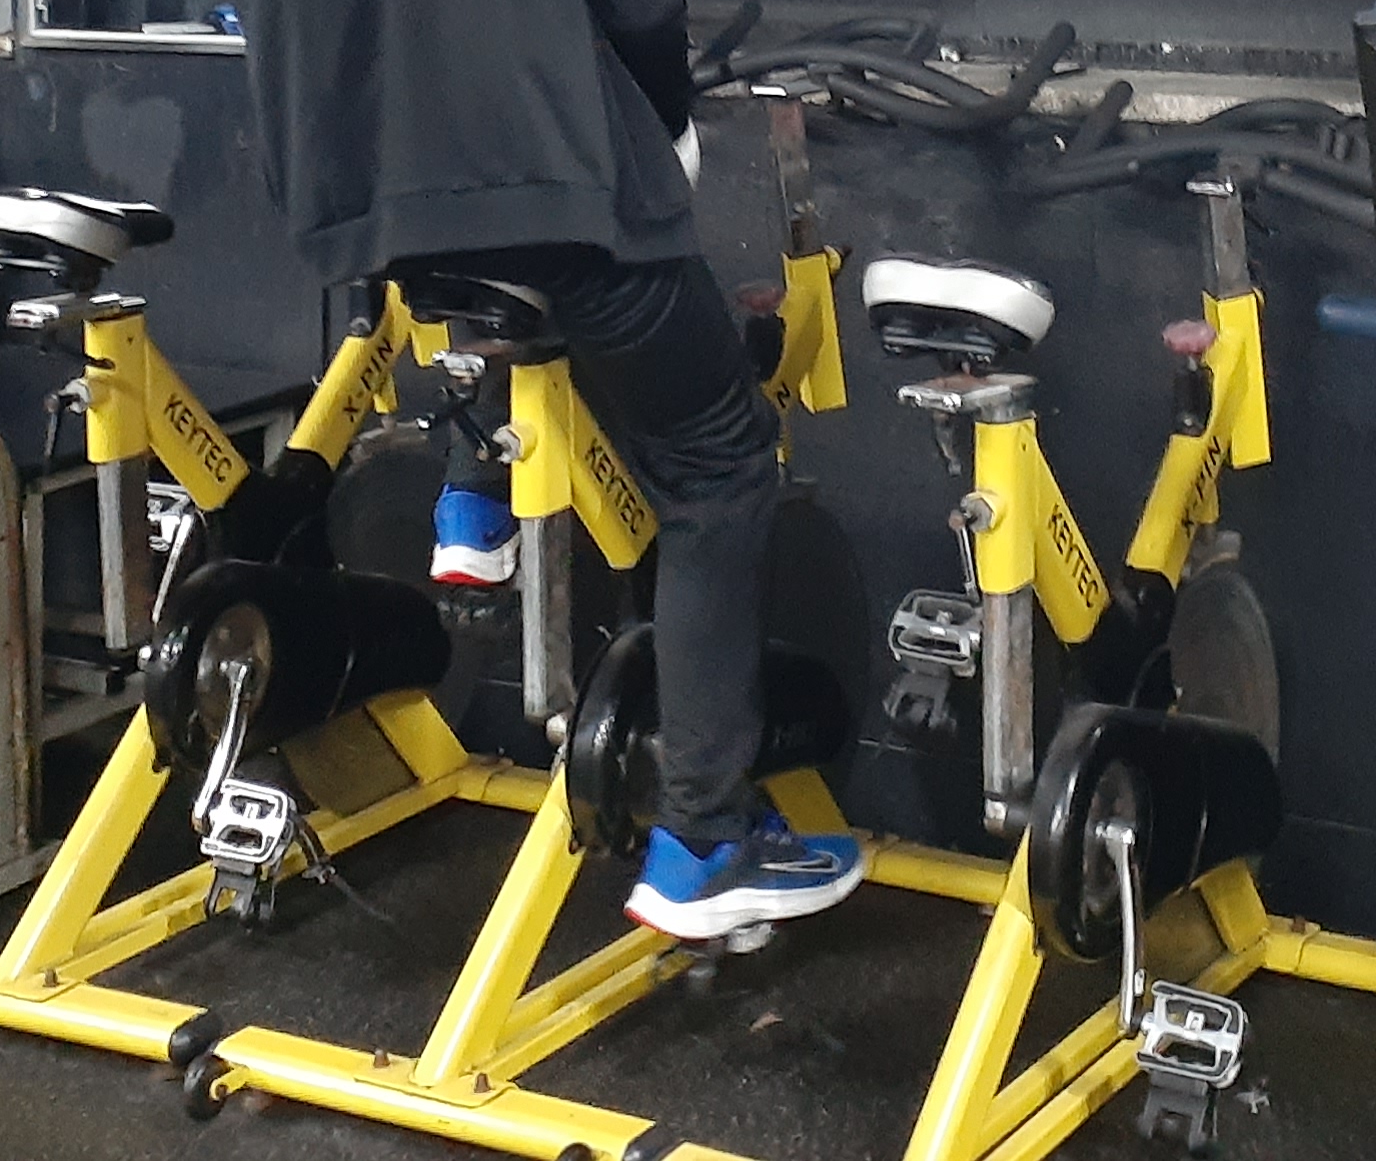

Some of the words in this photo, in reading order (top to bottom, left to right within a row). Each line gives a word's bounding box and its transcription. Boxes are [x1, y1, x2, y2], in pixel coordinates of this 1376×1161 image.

[163, 392, 234, 486] KEYTEC
[585, 438, 647, 536] KEYTEC
[1046, 502, 1101, 609] KEYTEC
